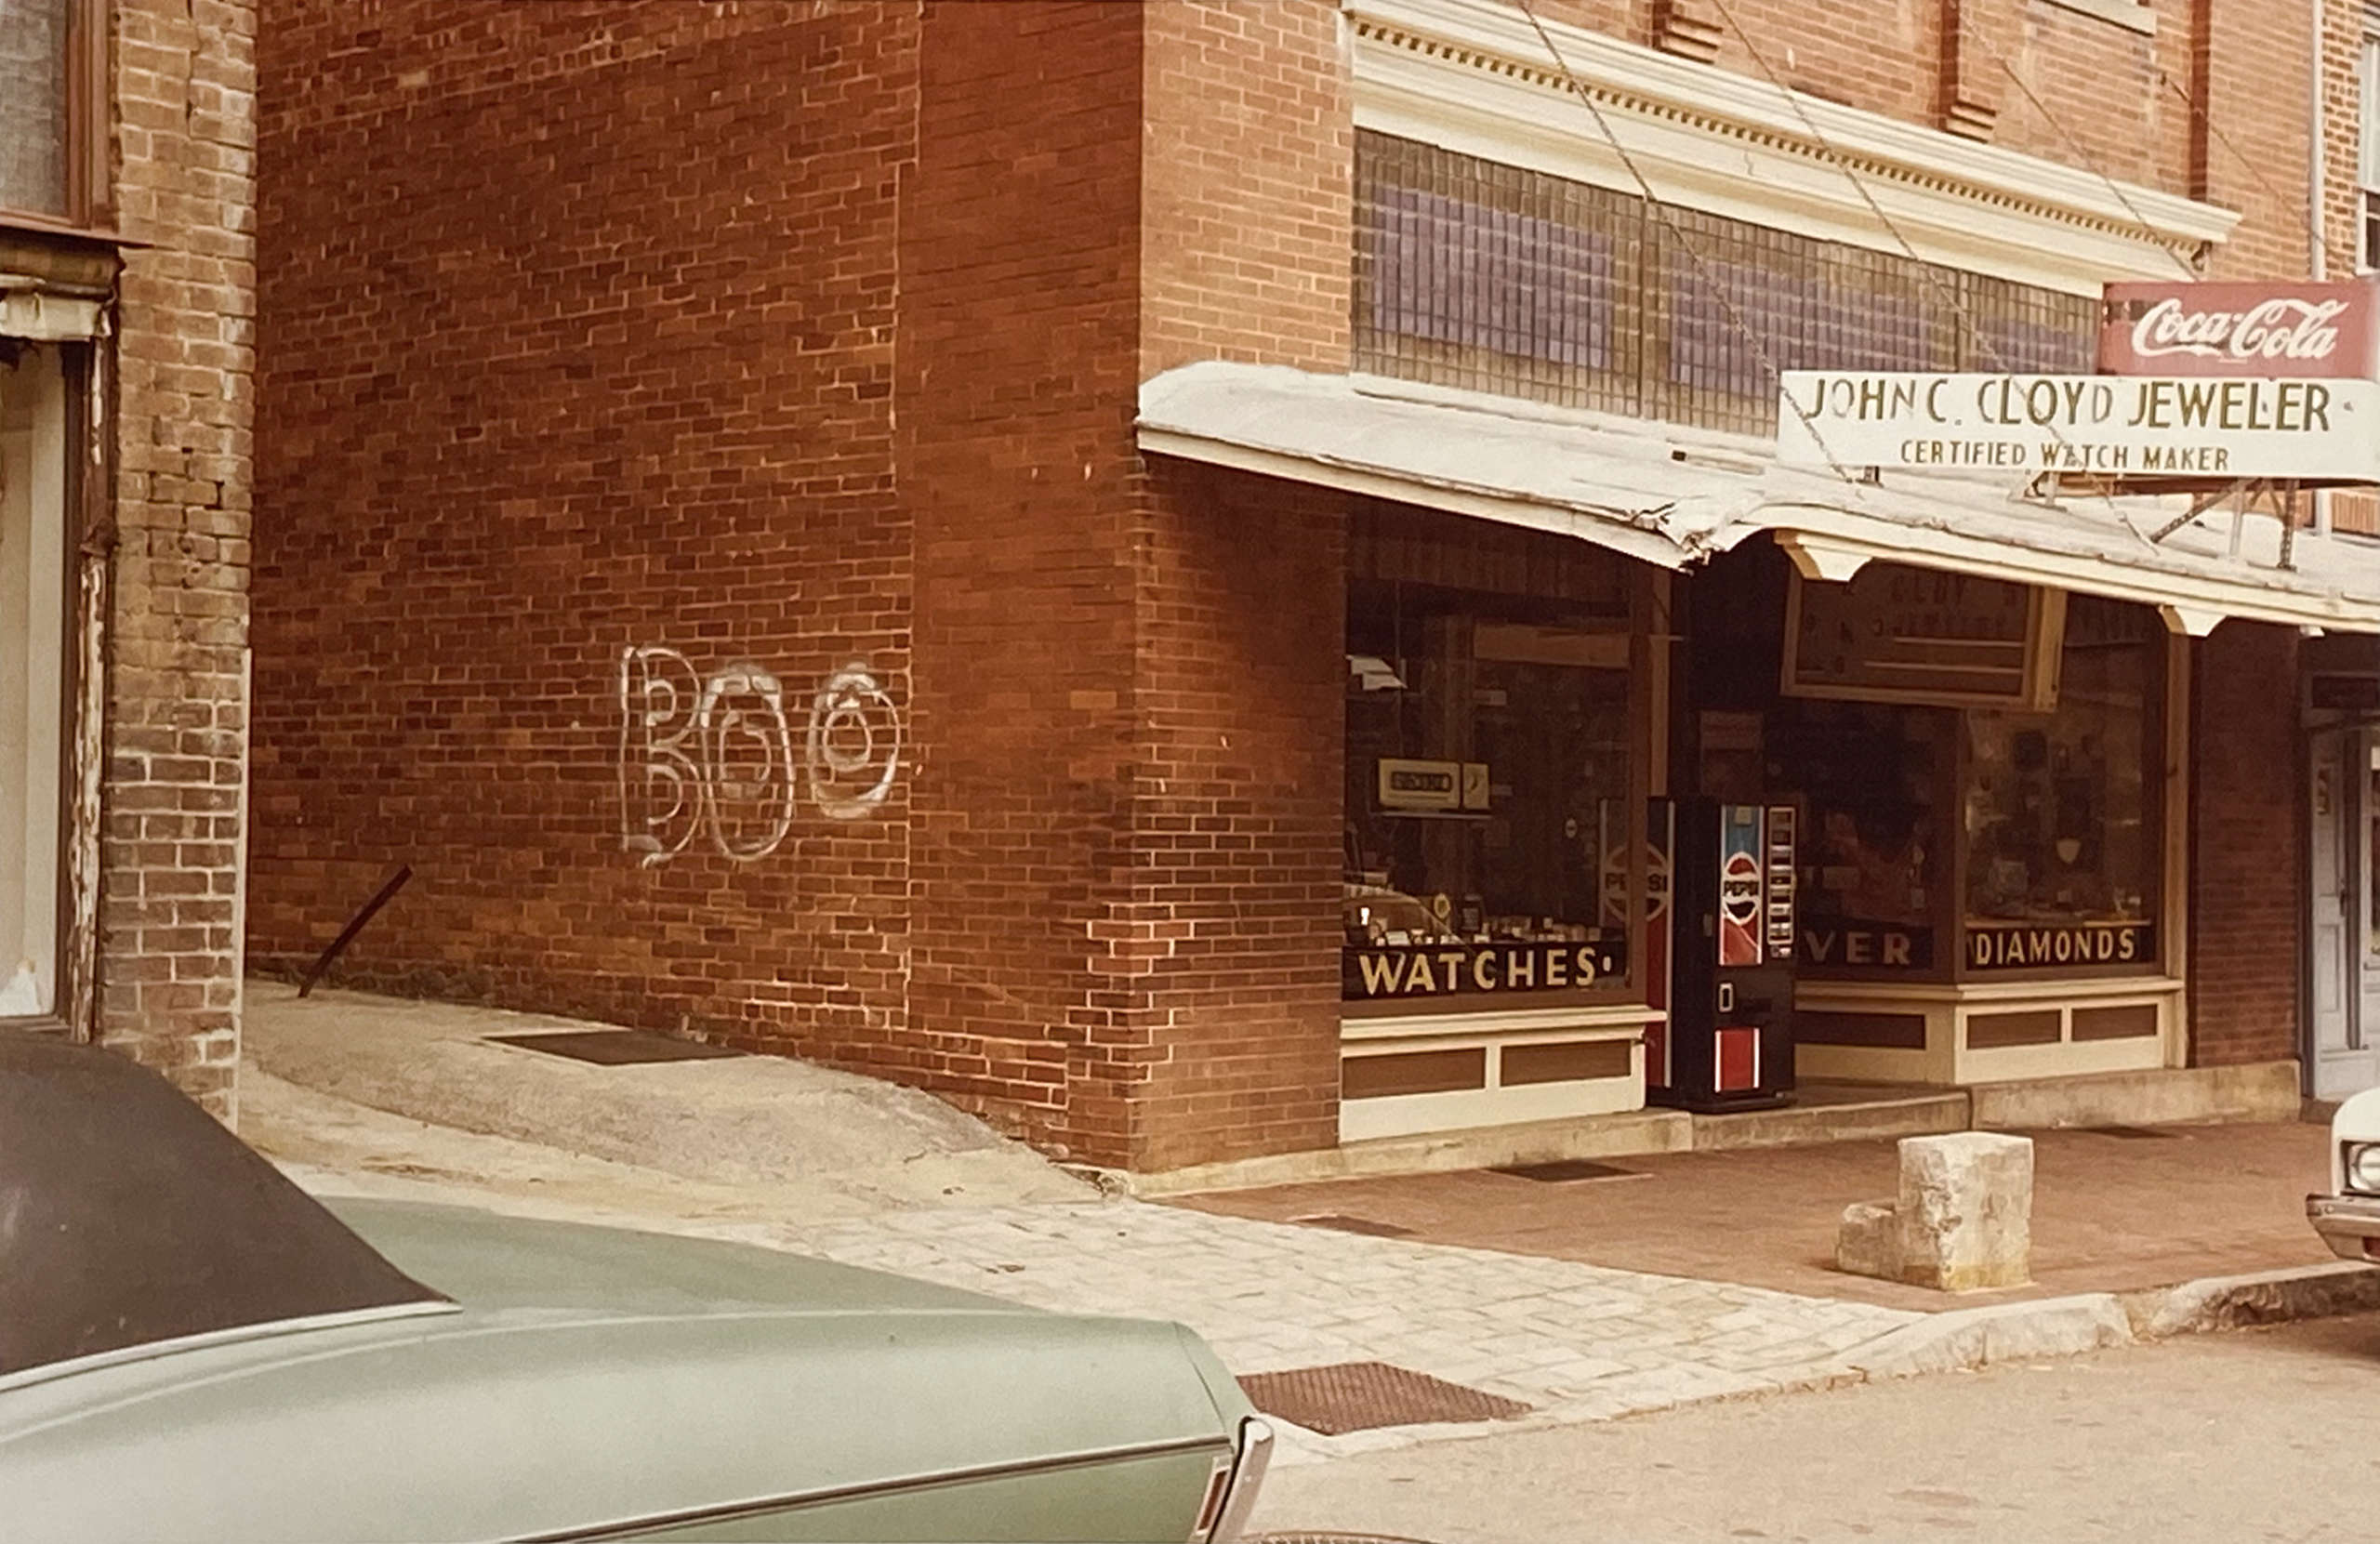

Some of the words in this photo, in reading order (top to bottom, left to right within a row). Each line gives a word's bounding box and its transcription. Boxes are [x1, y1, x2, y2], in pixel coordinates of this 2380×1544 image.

[2132, 297, 2350, 359] Coca-Cola
[1807, 378, 1916, 422] JOHN
[1977, 378, 2113, 427] CLOYD
[2127, 382, 2332, 432] JEWELER
[1899, 440, 2027, 466] CERTIFIED
[2041, 442, 2129, 469] WATCH
[2143, 446, 2229, 472] MAKER
[1605, 870, 1668, 892] PESI
[1801, 930, 1911, 966] VER
[1975, 928, 2135, 966] DIAMONDS
